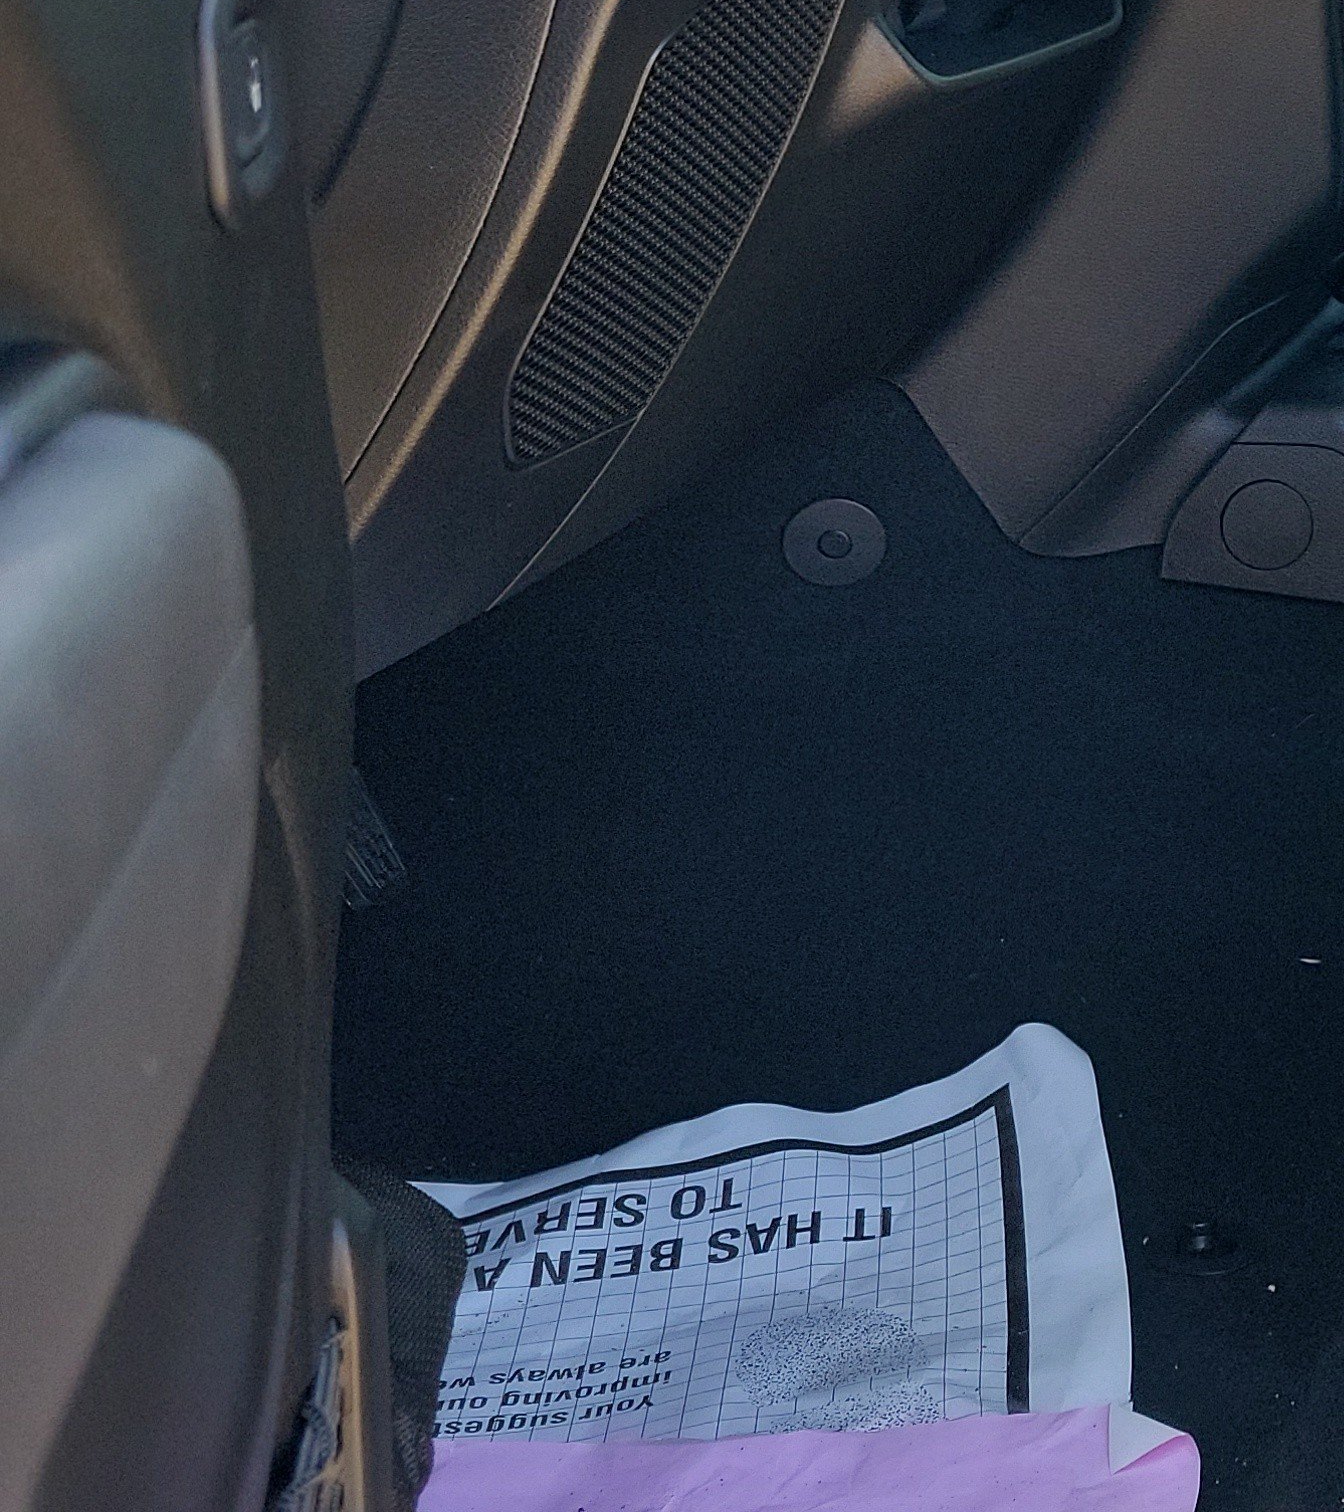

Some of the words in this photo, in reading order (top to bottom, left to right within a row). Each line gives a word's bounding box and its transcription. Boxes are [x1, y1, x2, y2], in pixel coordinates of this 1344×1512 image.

[670, 1177, 743, 1220] TO
[464, 1193, 647, 1258] SERVE
[707, 1210, 822, 1264] HAS
[843, 1206, 892, 1243] IT
[473, 1256, 512, 1292] A
[530, 1237, 683, 1288] BEEN
[489, 1360, 606, 1385] always
[620, 1349, 672, 1370] are
[501, 1370, 672, 1407] improving
[579, 1394, 654, 1420] Your
